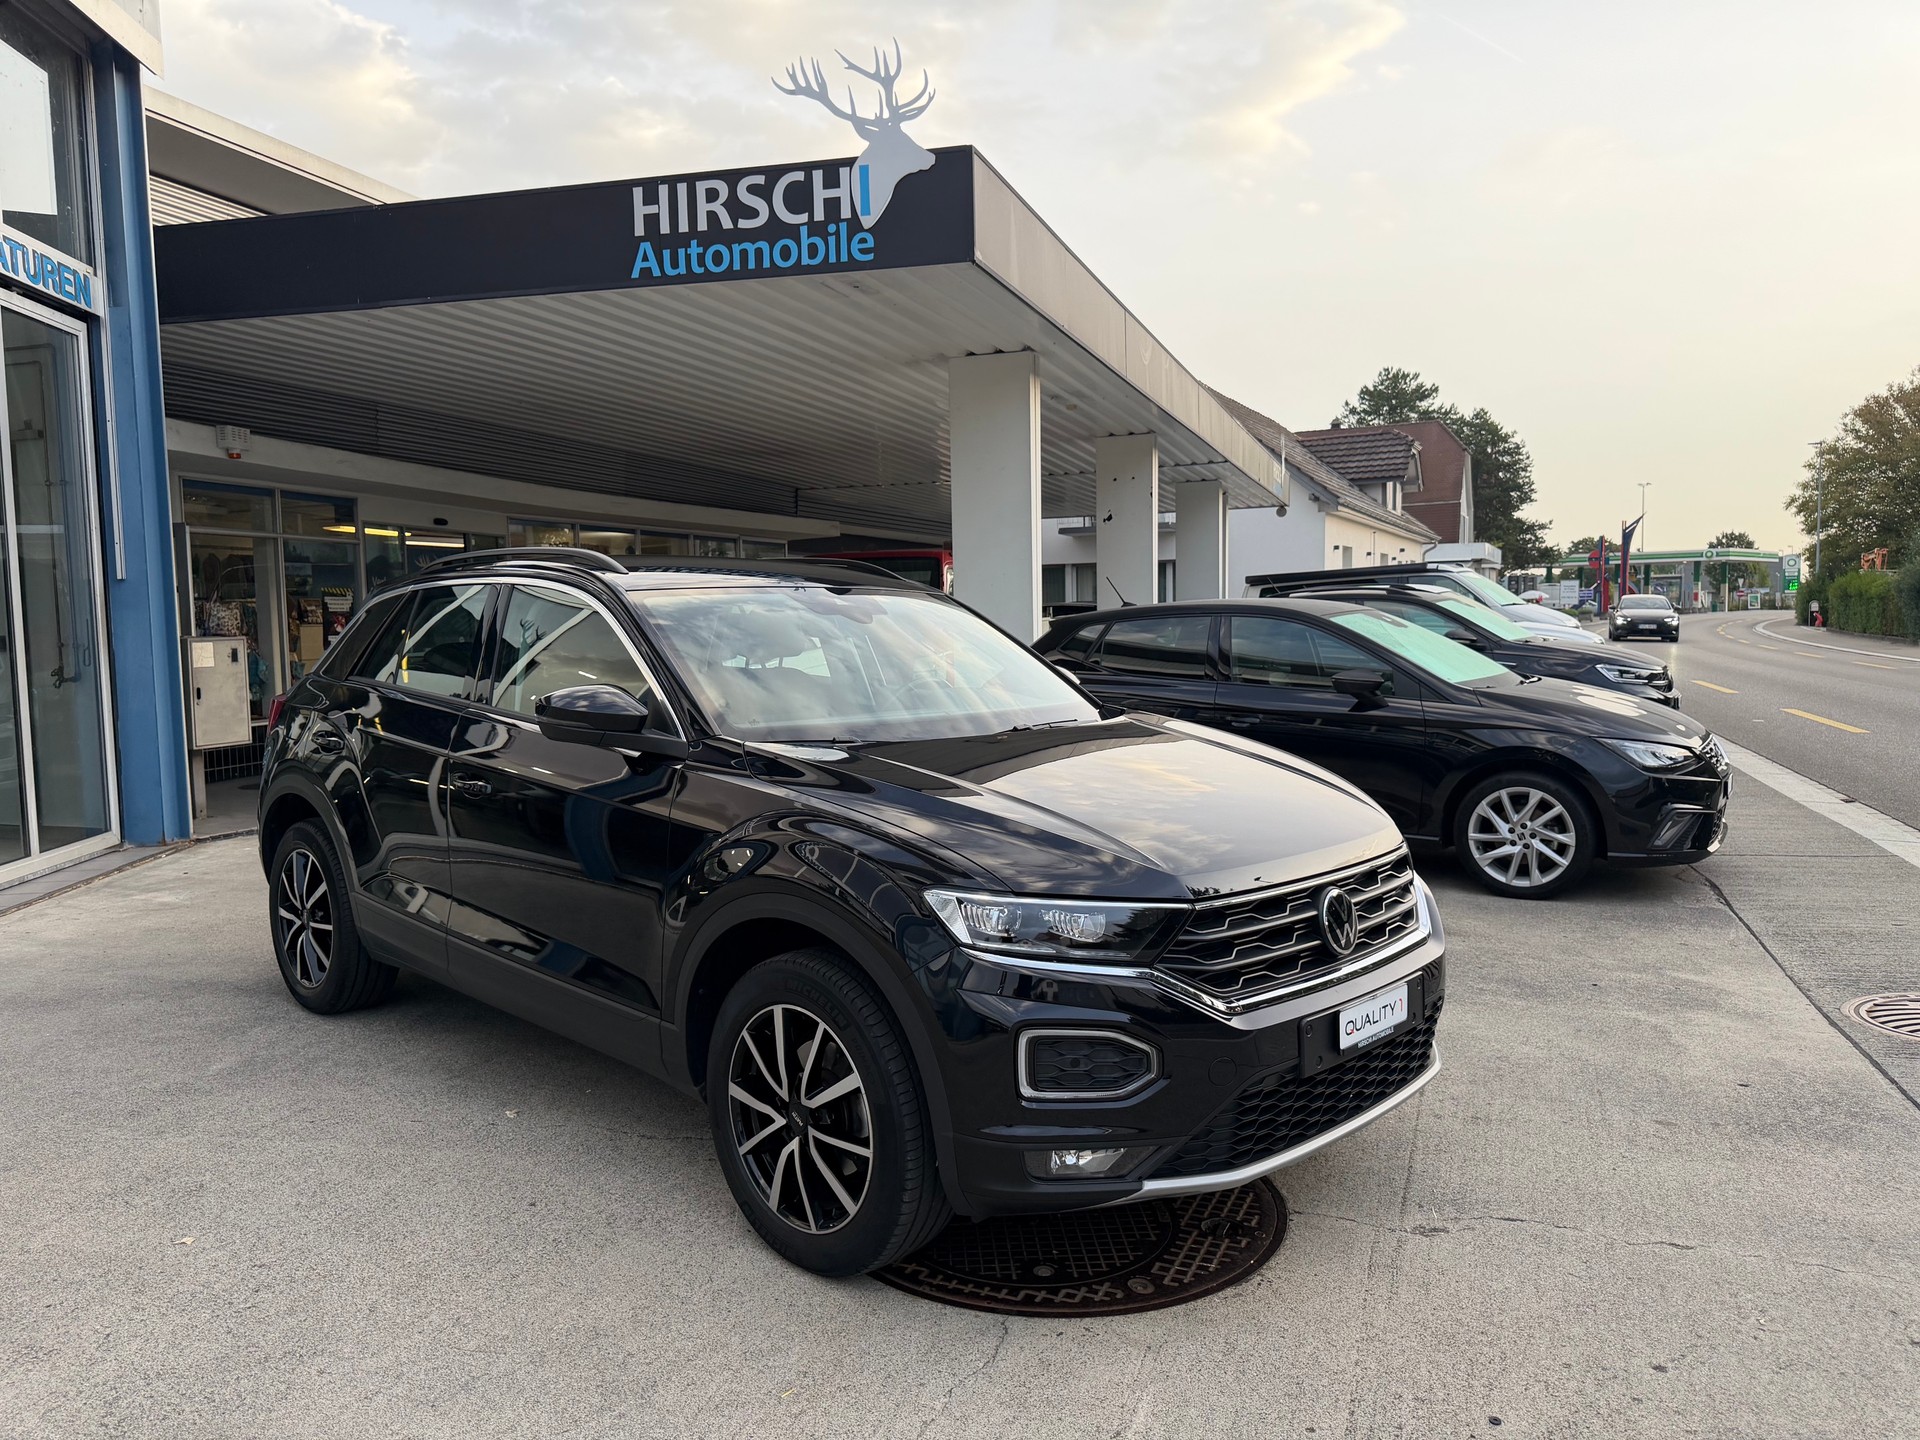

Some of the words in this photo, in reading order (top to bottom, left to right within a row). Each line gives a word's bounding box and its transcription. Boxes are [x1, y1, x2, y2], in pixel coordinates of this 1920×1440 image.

[632, 164, 872, 237] HIRSCHI
[631, 221, 875, 279] Automobile
[1344, 999, 1397, 1036] QUALITY
